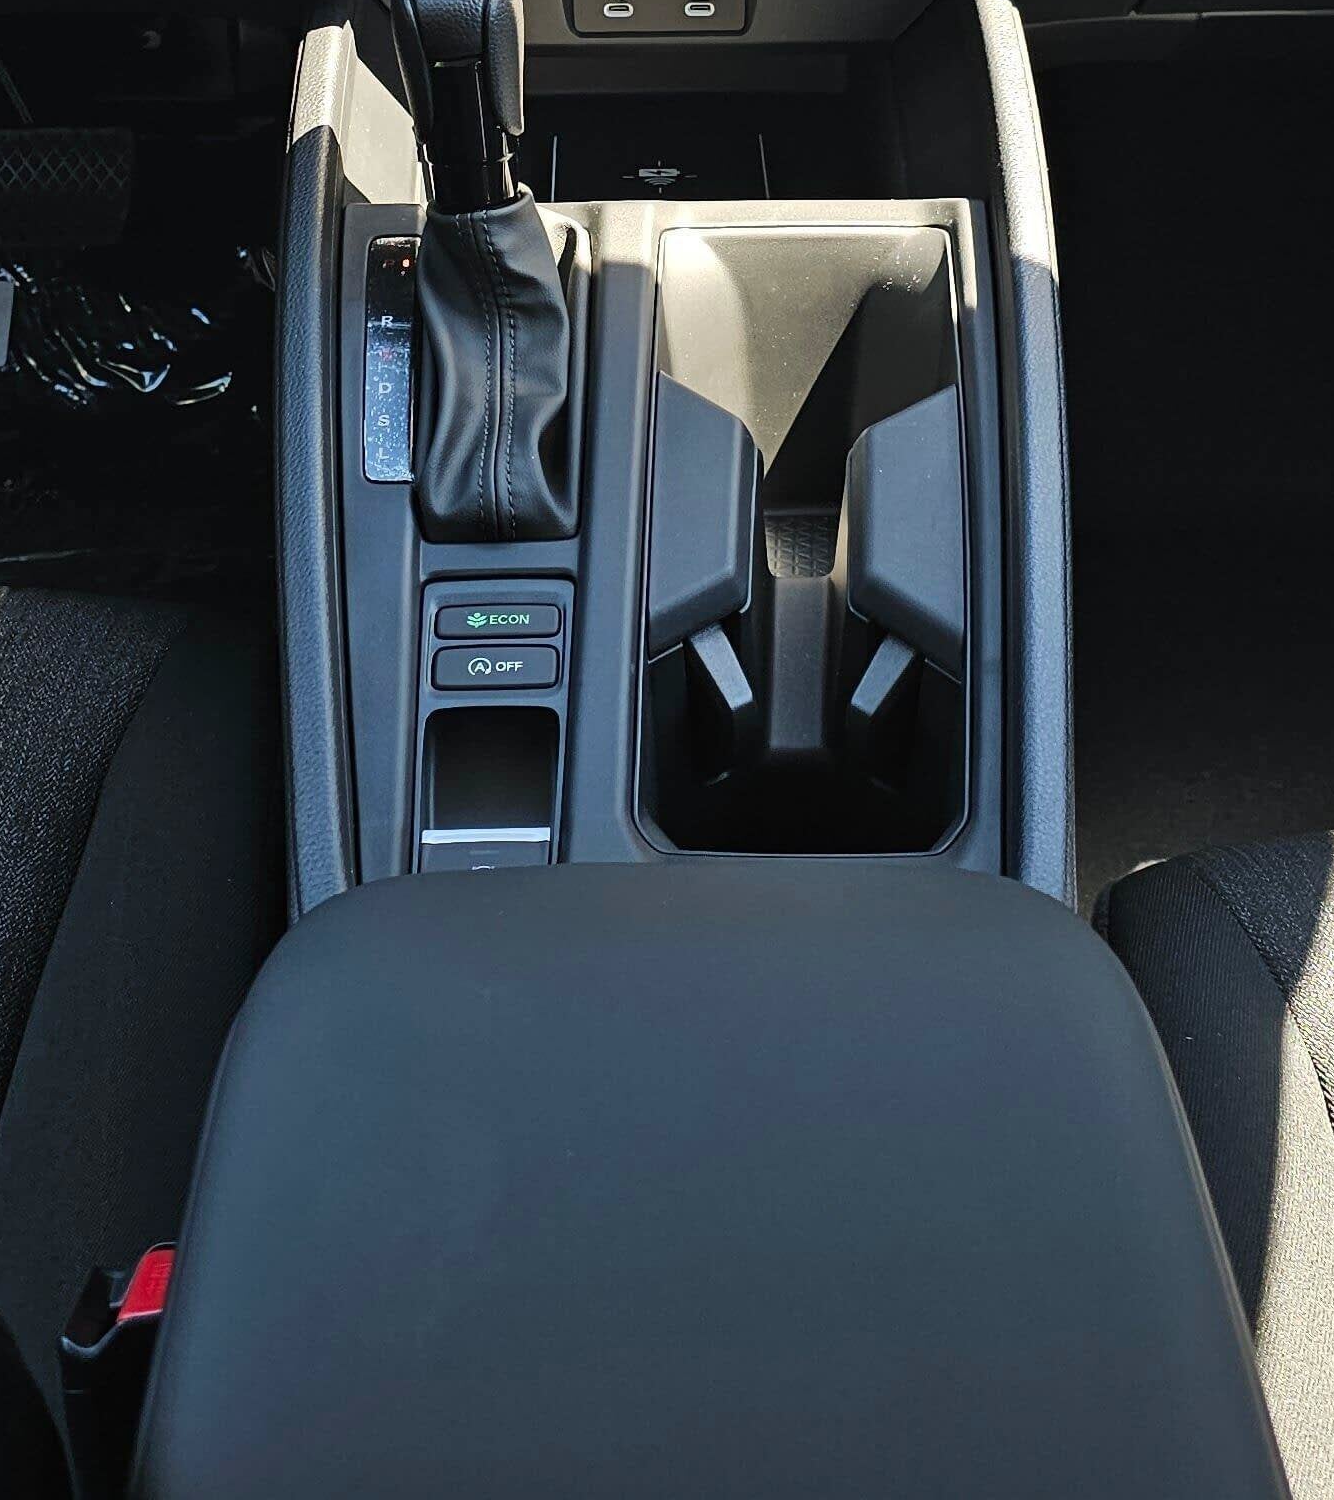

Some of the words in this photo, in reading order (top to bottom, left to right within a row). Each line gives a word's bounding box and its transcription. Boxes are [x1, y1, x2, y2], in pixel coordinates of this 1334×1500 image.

[381, 315, 394, 328] R
[378, 382, 392, 395] D
[377, 414, 390, 427] S
[489, 614, 530, 625] ECON
[495, 661, 524, 672] OFF
